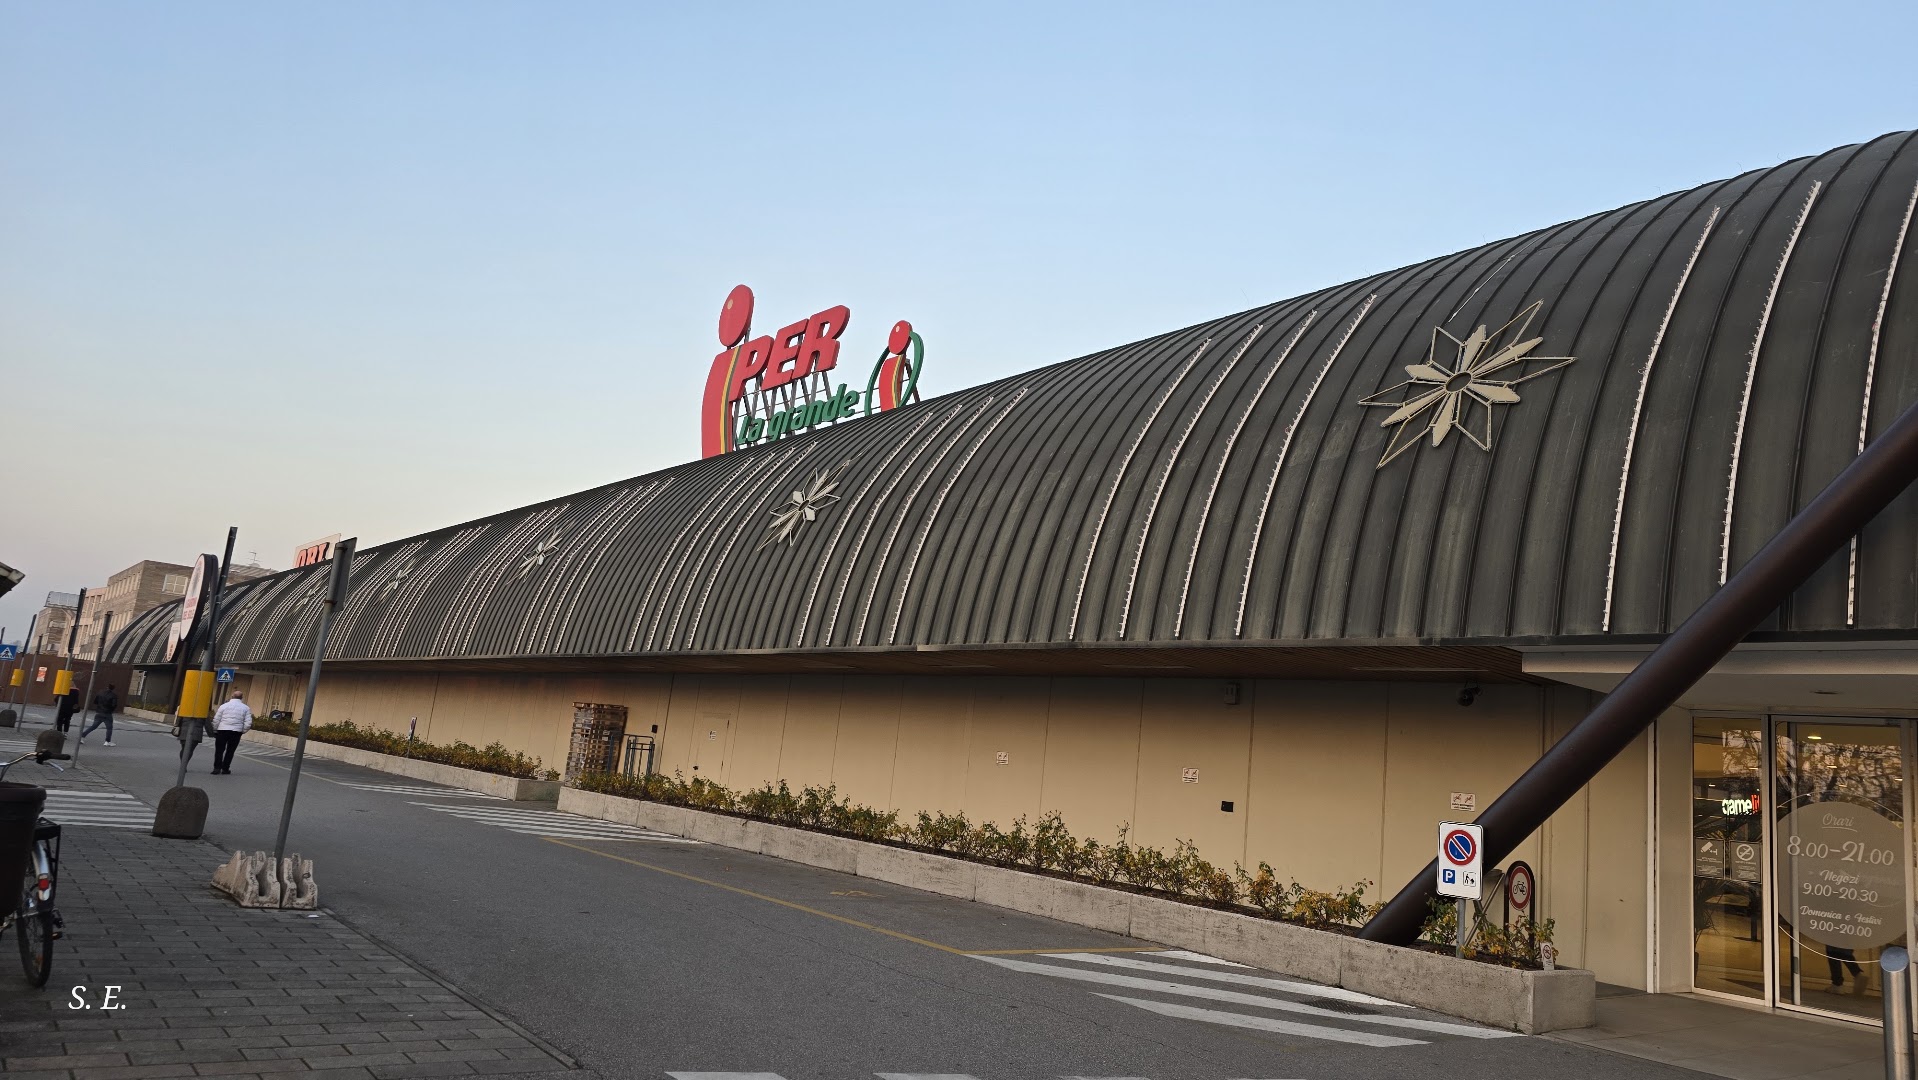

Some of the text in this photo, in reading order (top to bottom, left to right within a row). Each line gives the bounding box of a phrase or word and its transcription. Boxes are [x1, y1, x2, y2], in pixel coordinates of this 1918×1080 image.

[767, 383, 860, 442] grande
[1822, 813, 1854, 827] Orari
[1787, 835, 1894, 866] 8.00-21.00
[1819, 869, 1860, 886] Negozi
[1802, 882, 1878, 903] 9.00-20.30
[1800, 905, 1842, 920] Domenica
[1809, 919, 1873, 938] 9.00-20.00
